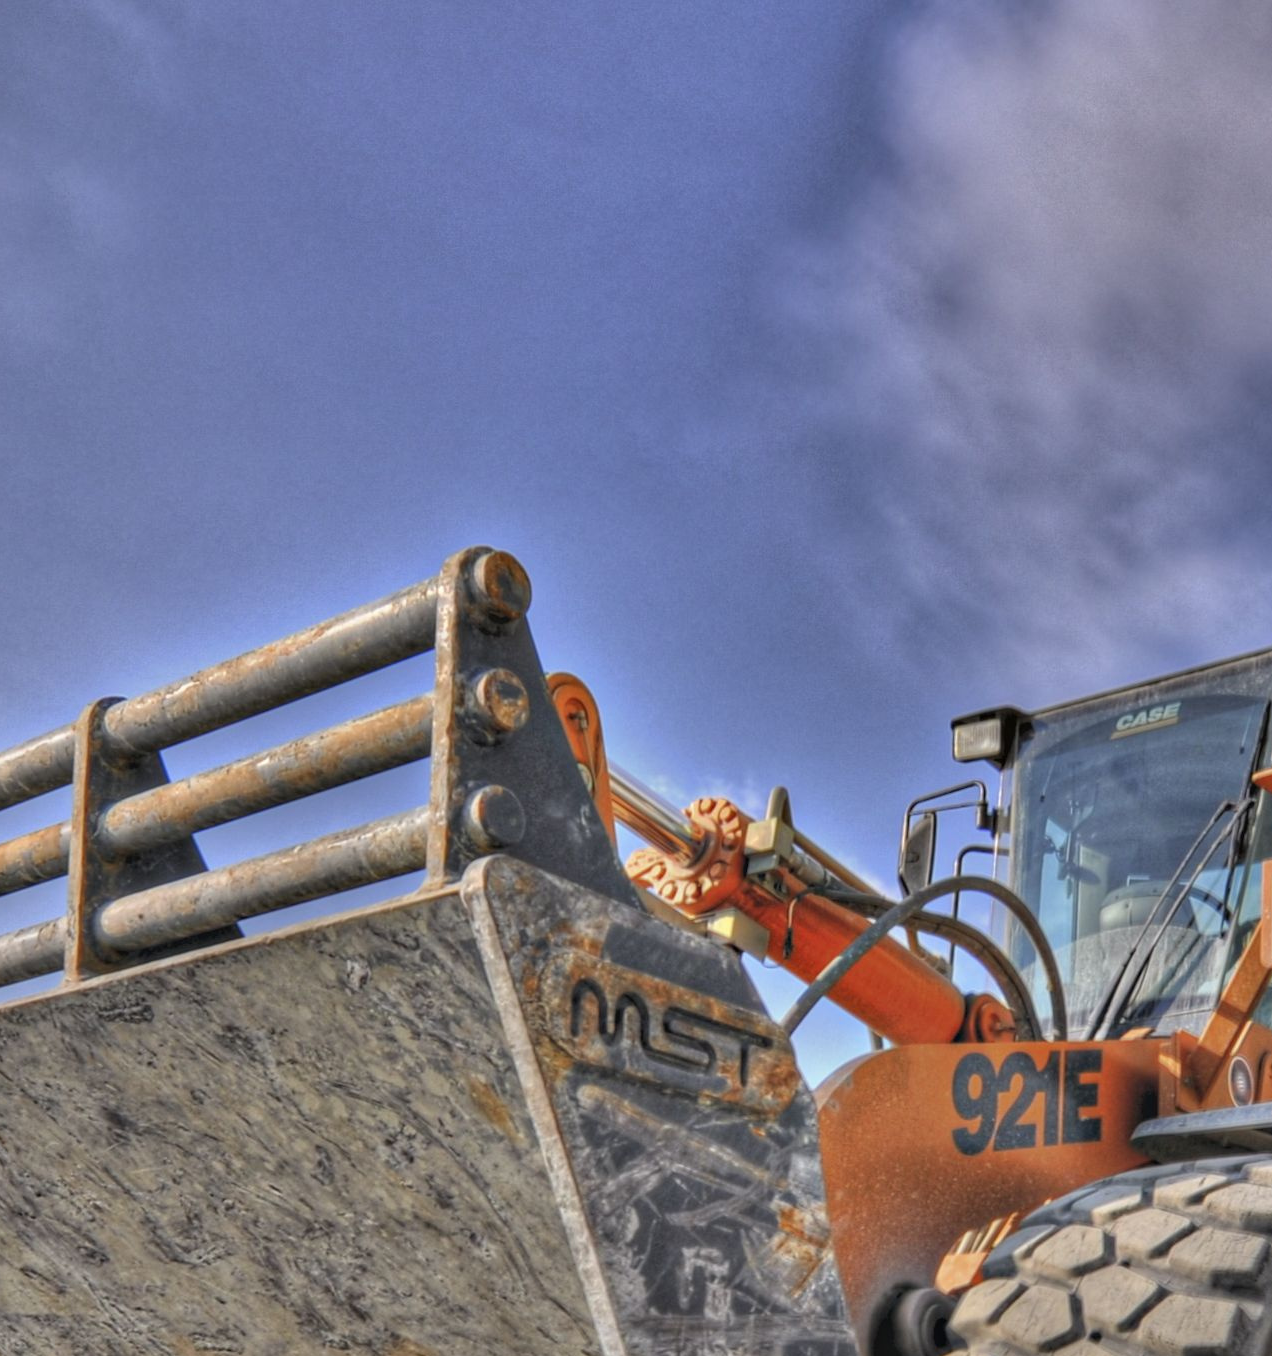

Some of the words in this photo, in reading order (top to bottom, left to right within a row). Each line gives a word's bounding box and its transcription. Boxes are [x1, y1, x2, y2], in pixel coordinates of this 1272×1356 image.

[1115, 701, 1182, 731] CASE
[570, 978, 774, 1088] MST
[951, 1049, 1104, 1157] 921E
